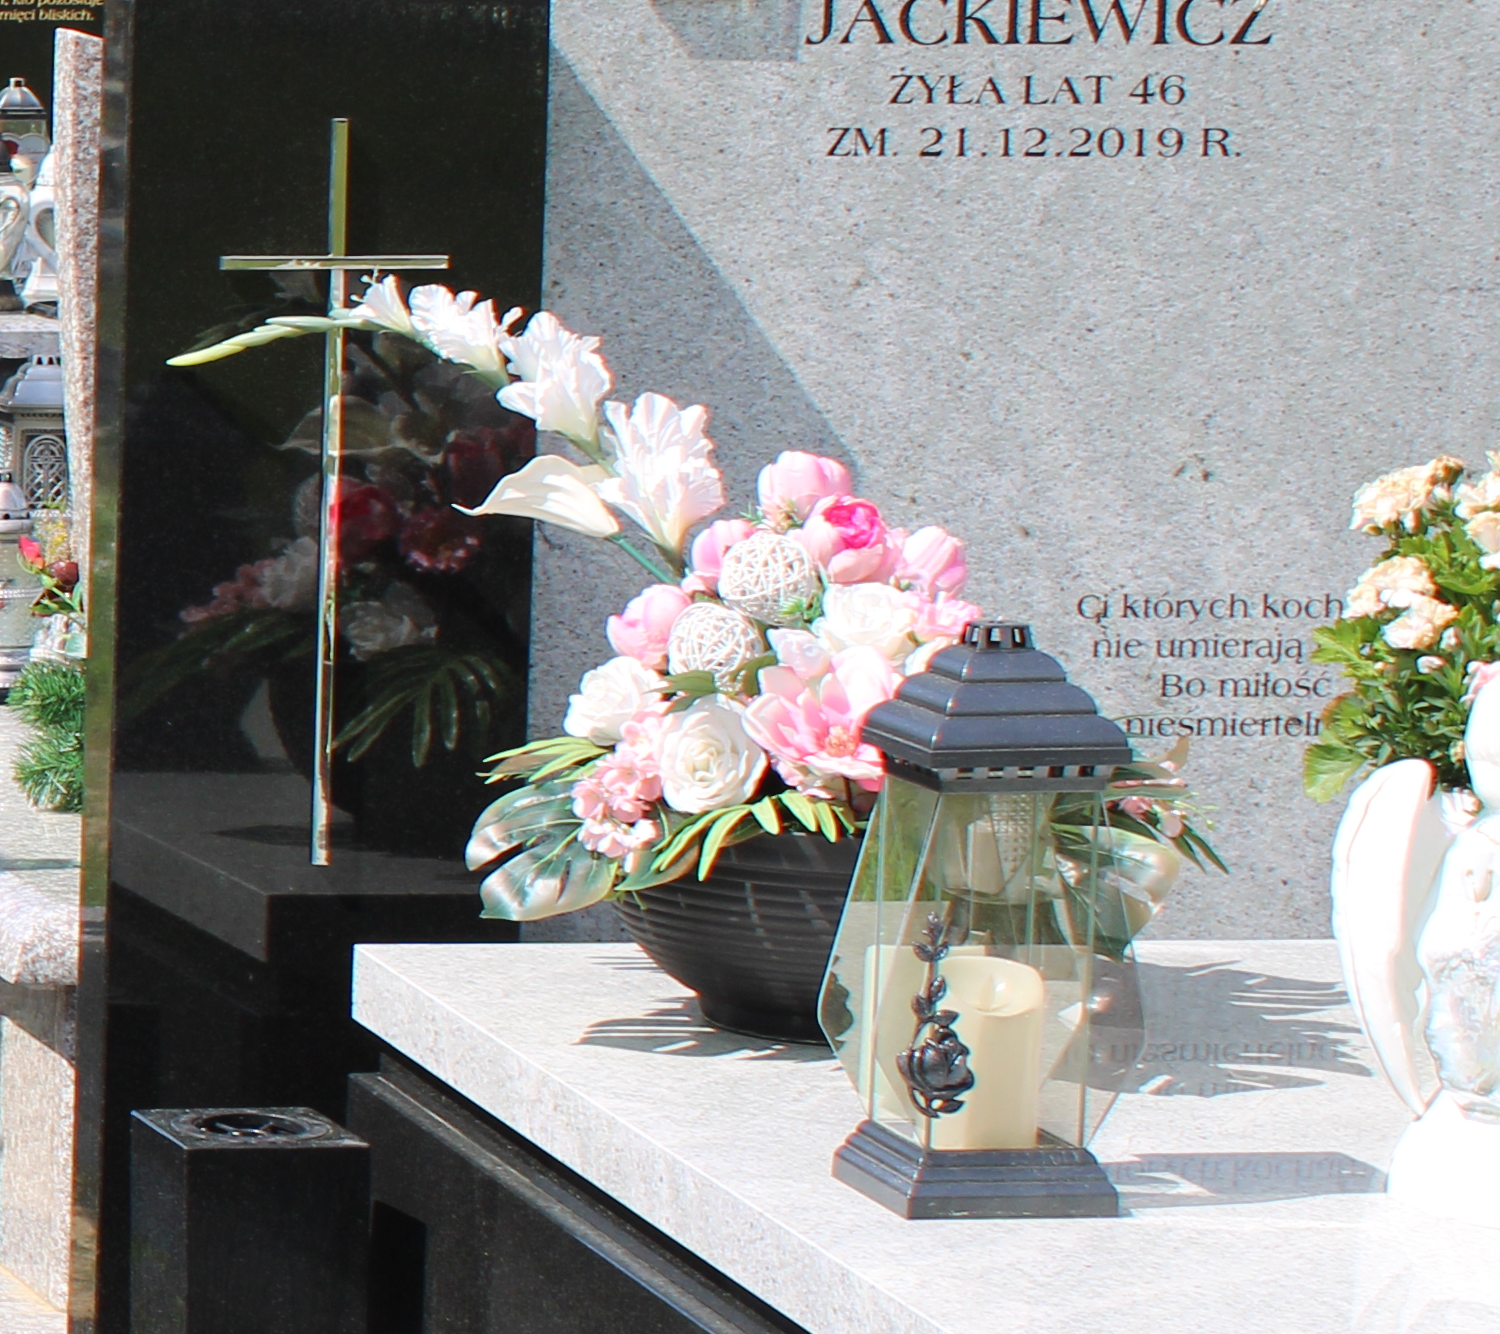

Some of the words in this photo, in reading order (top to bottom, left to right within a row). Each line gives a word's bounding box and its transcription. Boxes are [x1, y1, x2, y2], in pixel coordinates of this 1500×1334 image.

[38, 9, 95, 20] bliskich.
[888, 66, 1005, 105] ŻYŁA
[1023, 75, 1114, 105] LAT
[1128, 74, 1187, 106] 46
[826, 128, 898, 157] ZM.
[919, 127, 1185, 158] 21.12.2019
[1201, 128, 1242, 157] R.
[1123, 593, 1249, 624] których
[1091, 633, 1144, 658] nie
[1155, 633, 1303, 663] umierają
[1160, 673, 1206, 698] Bo
[1218, 671, 1332, 698] miłość
